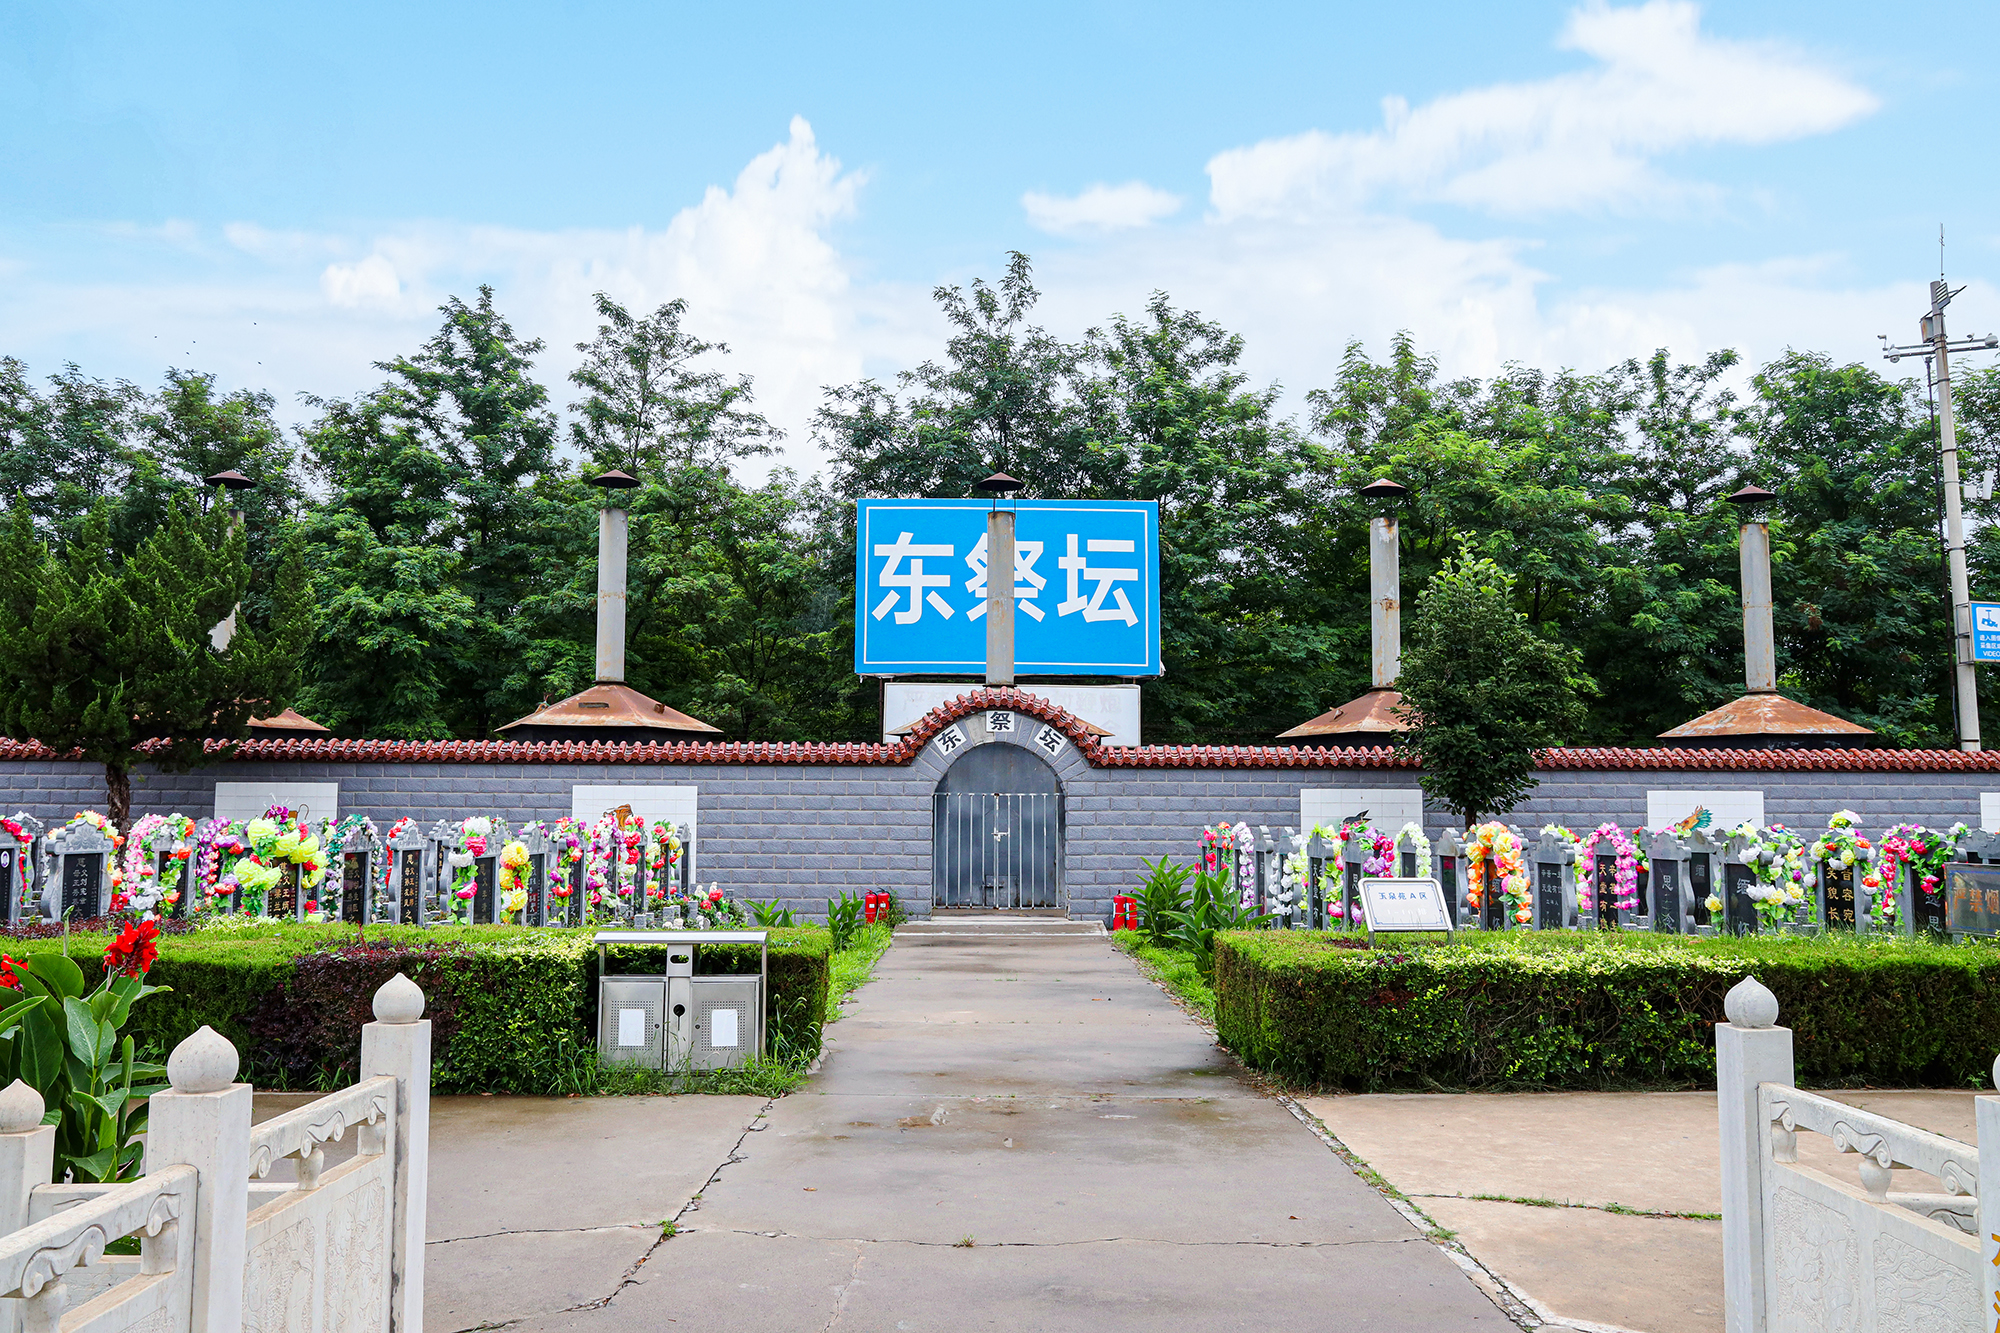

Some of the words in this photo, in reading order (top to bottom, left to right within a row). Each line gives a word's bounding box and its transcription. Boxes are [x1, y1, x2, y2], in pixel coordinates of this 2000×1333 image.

[872, 531, 1139, 627] 东祭坛
[938, 711, 1062, 752] 东祭坛
[1825, 867, 1840, 931] 笑貌长
[1840, 867, 1855, 934] 音容宛
